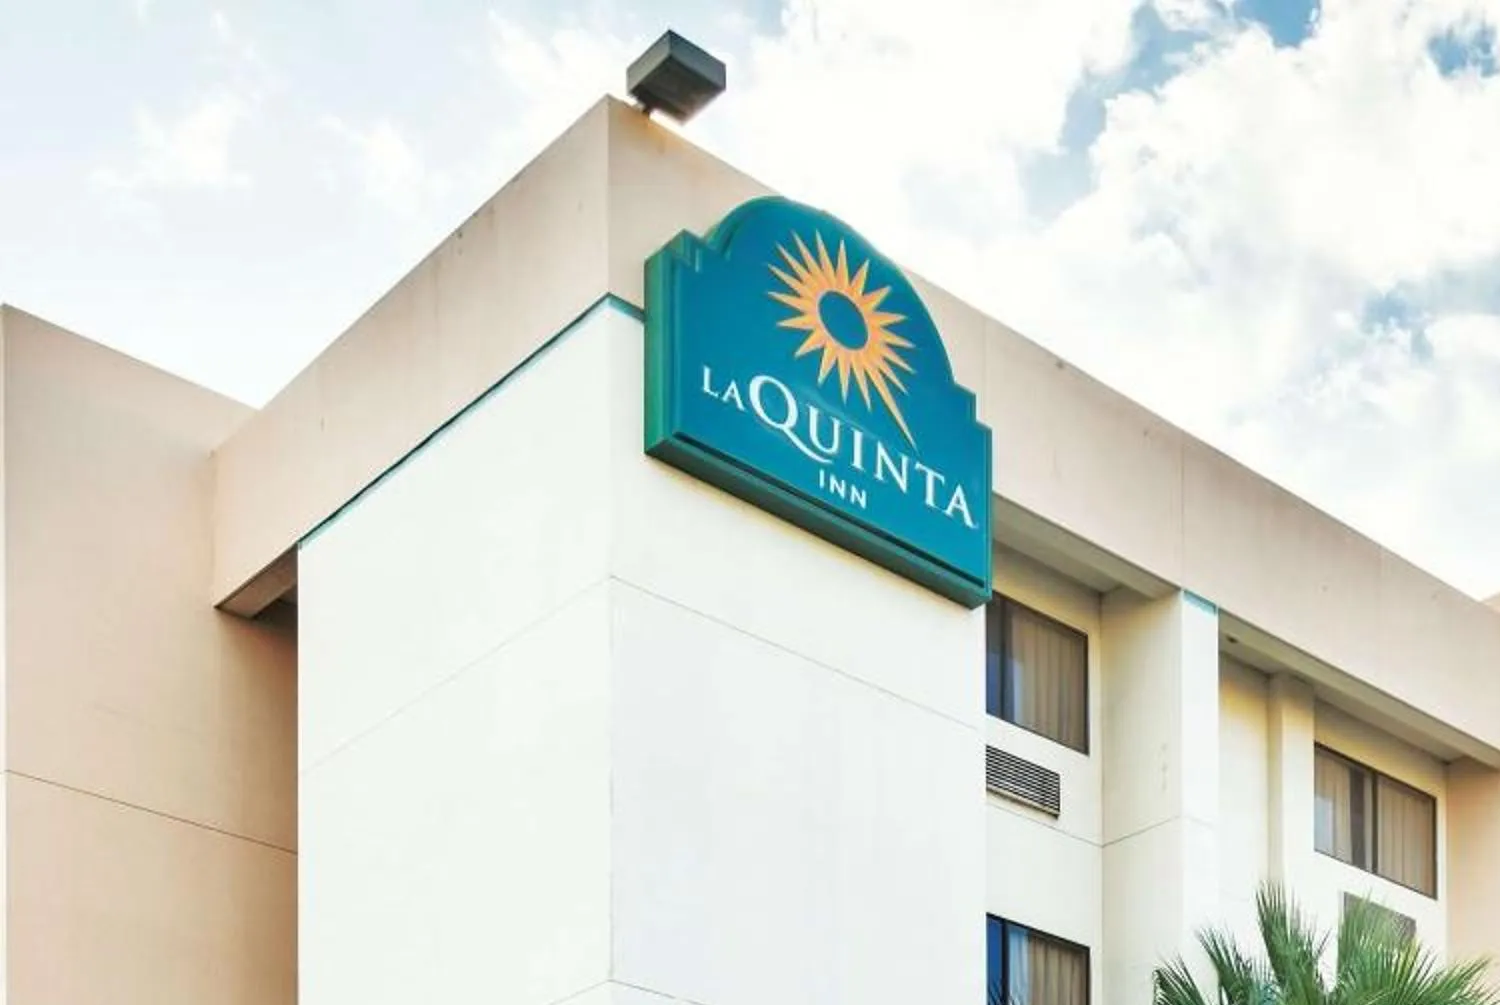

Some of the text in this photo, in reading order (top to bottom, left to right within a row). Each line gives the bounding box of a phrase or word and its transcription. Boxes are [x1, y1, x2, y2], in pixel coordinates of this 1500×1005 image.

[703, 365, 979, 530] LA QUINTA
[819, 468, 867, 509] INN
